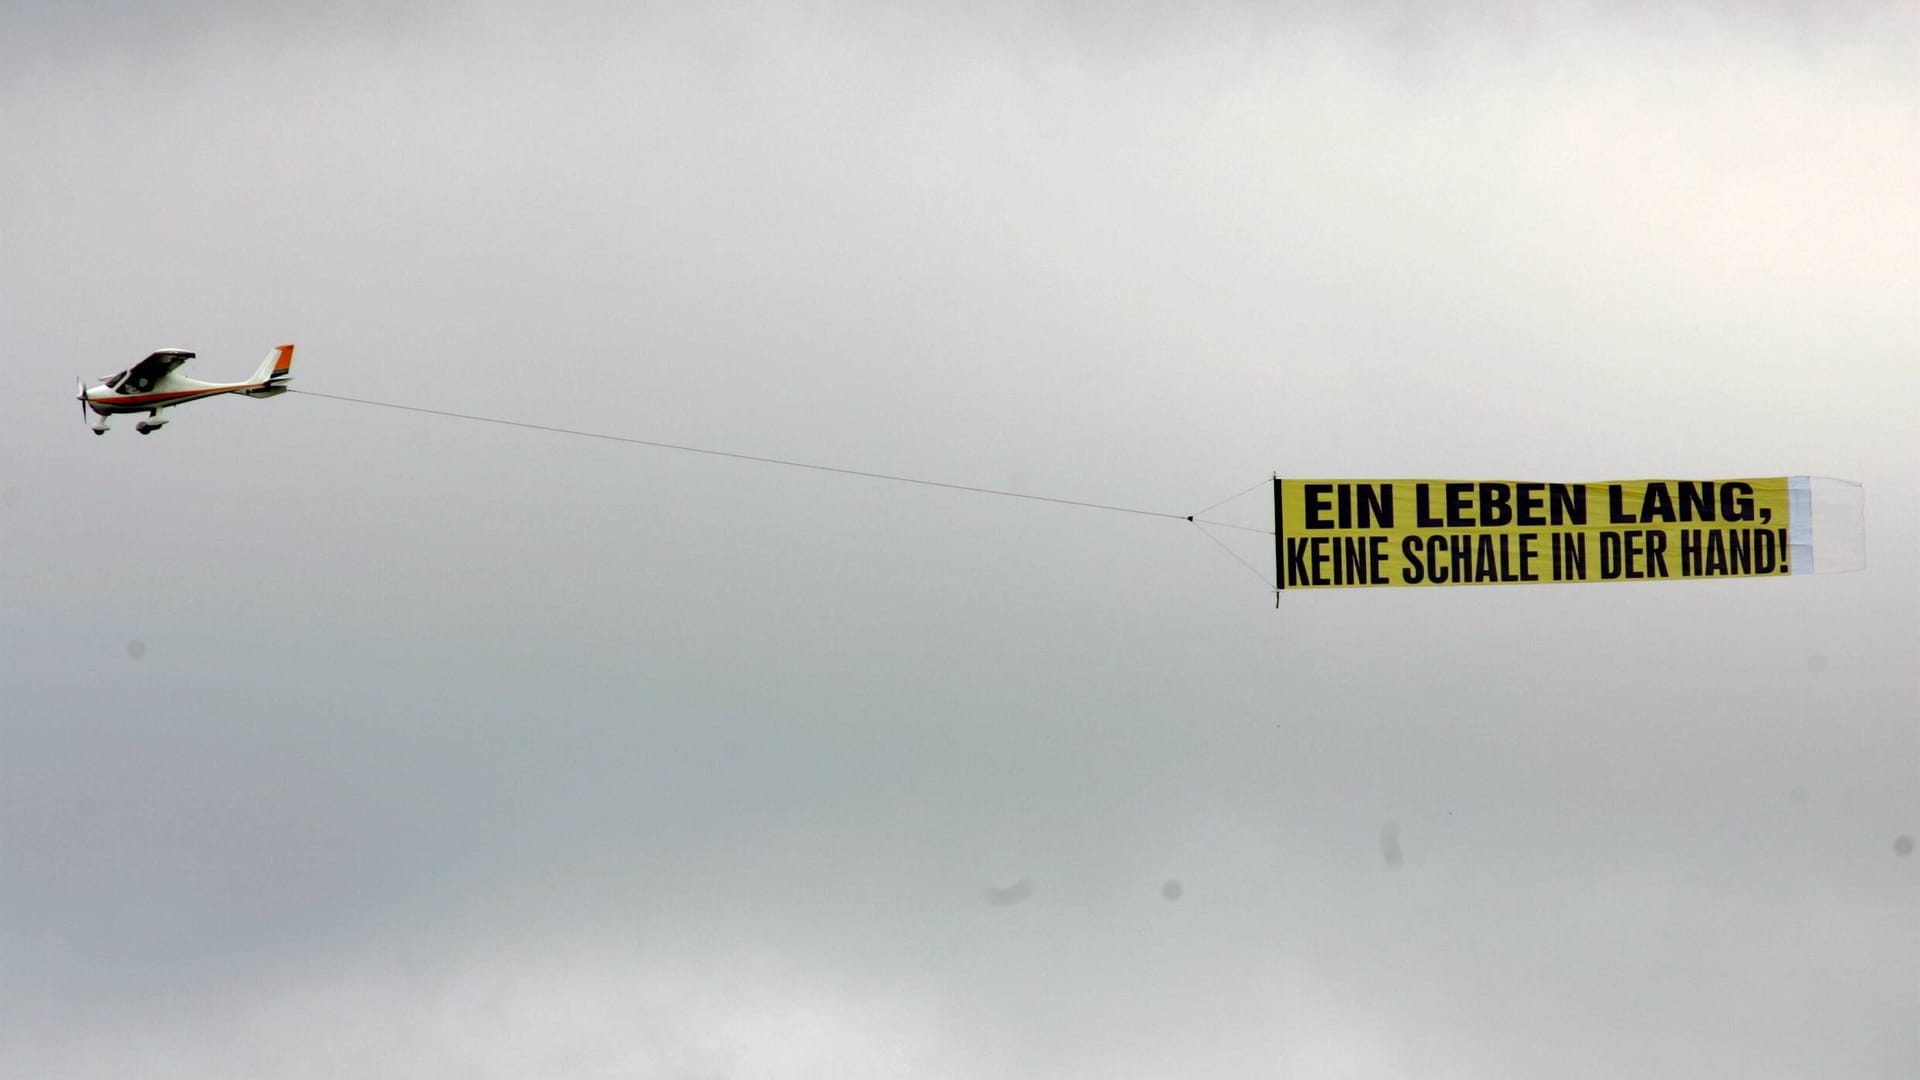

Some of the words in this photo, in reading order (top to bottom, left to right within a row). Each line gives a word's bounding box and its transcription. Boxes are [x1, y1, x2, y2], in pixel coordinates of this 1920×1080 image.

[1304, 483, 1395, 530] EIN
[1415, 482, 1587, 529] LEBEN
[1608, 480, 1772, 525] LANG,
[1286, 535, 1390, 587] KEINE
[1401, 532, 1539, 585] SCHALE
[1551, 531, 1587, 581] IN
[1599, 529, 1669, 580] DER
[1680, 528, 1789, 577] HAND!
